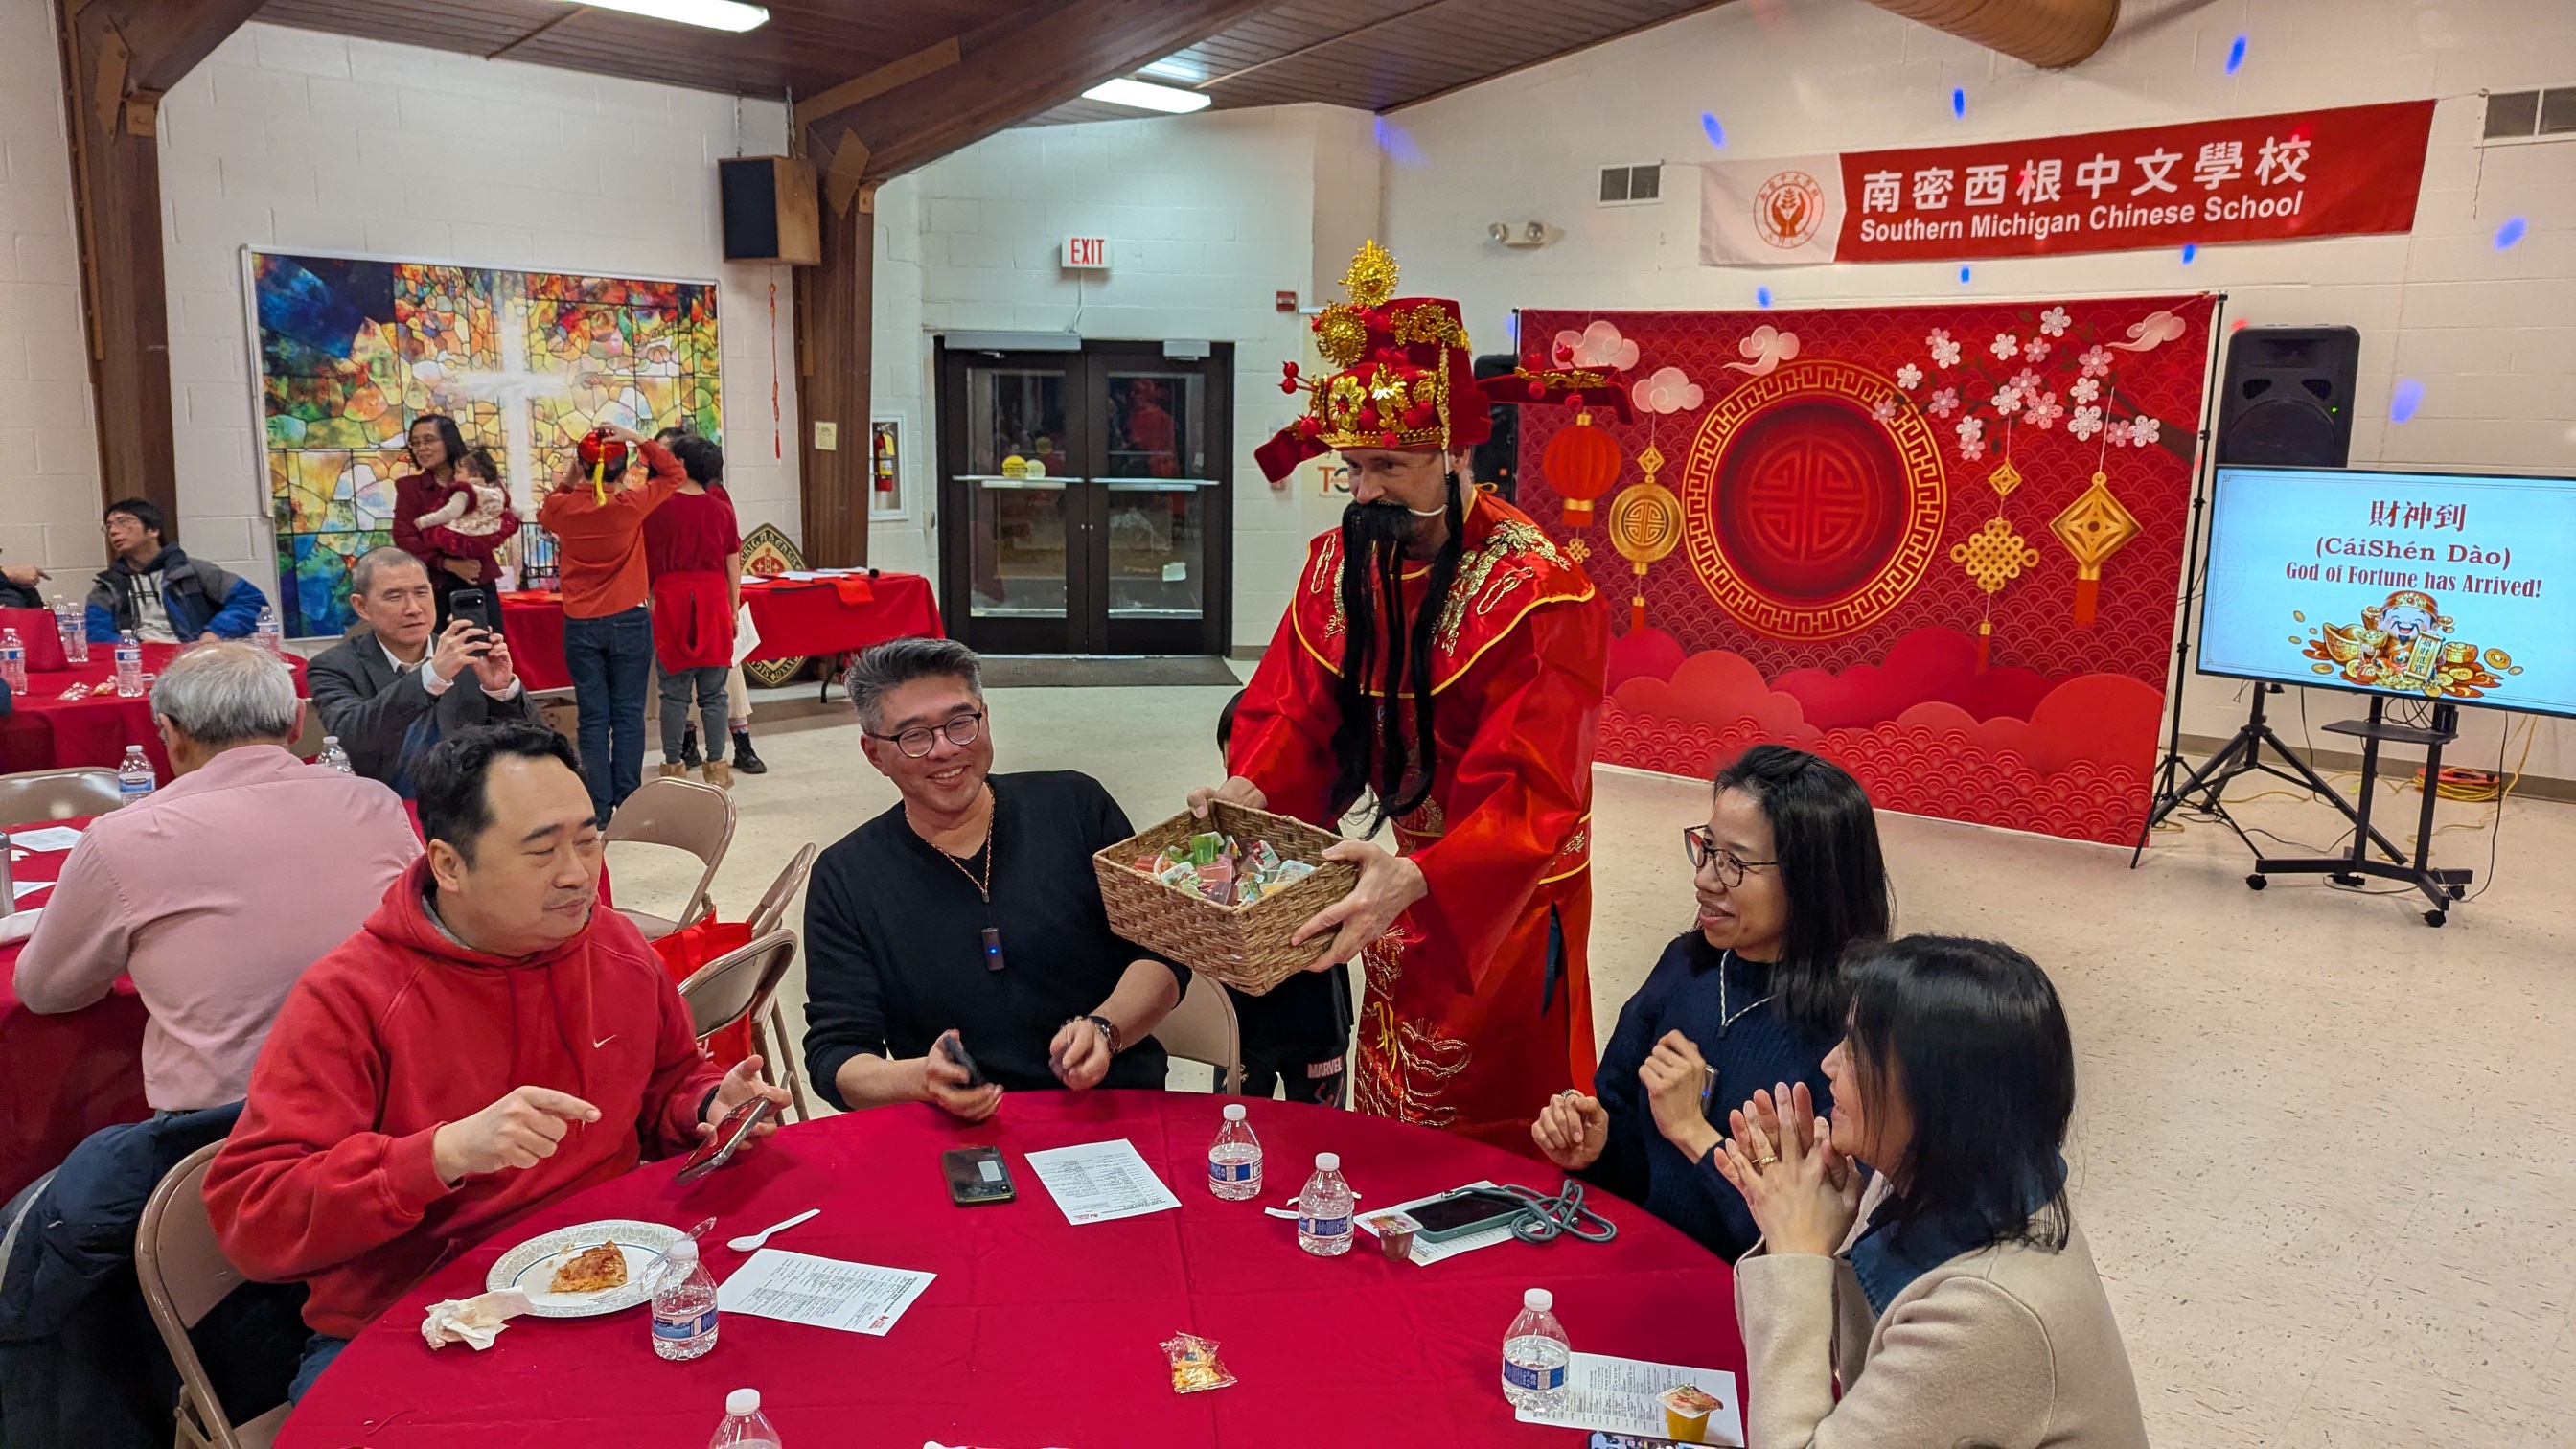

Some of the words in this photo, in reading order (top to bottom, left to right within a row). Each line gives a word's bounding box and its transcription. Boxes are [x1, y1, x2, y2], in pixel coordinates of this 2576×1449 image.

[1862, 134, 2312, 214] 南密西根中文學校
[1860, 218, 1963, 242] Southern
[1970, 211, 2081, 240] Michigan
[2089, 203, 2195, 230] Chinese
[2204, 190, 2304, 221] School
[1070, 238, 1105, 264] EXIT
[2368, 500, 2467, 532] 財神到
[2316, 537, 2436, 561] (CáiShén
[2447, 544, 2511, 571] Dào)
[2286, 562, 2319, 581] God
[2325, 564, 2343, 583] of
[2348, 566, 2418, 588] Fortune
[2424, 571, 2456, 591] has
[2462, 574, 2542, 598] Arrived!
[1307, 1056, 1342, 1078] MARVEL
